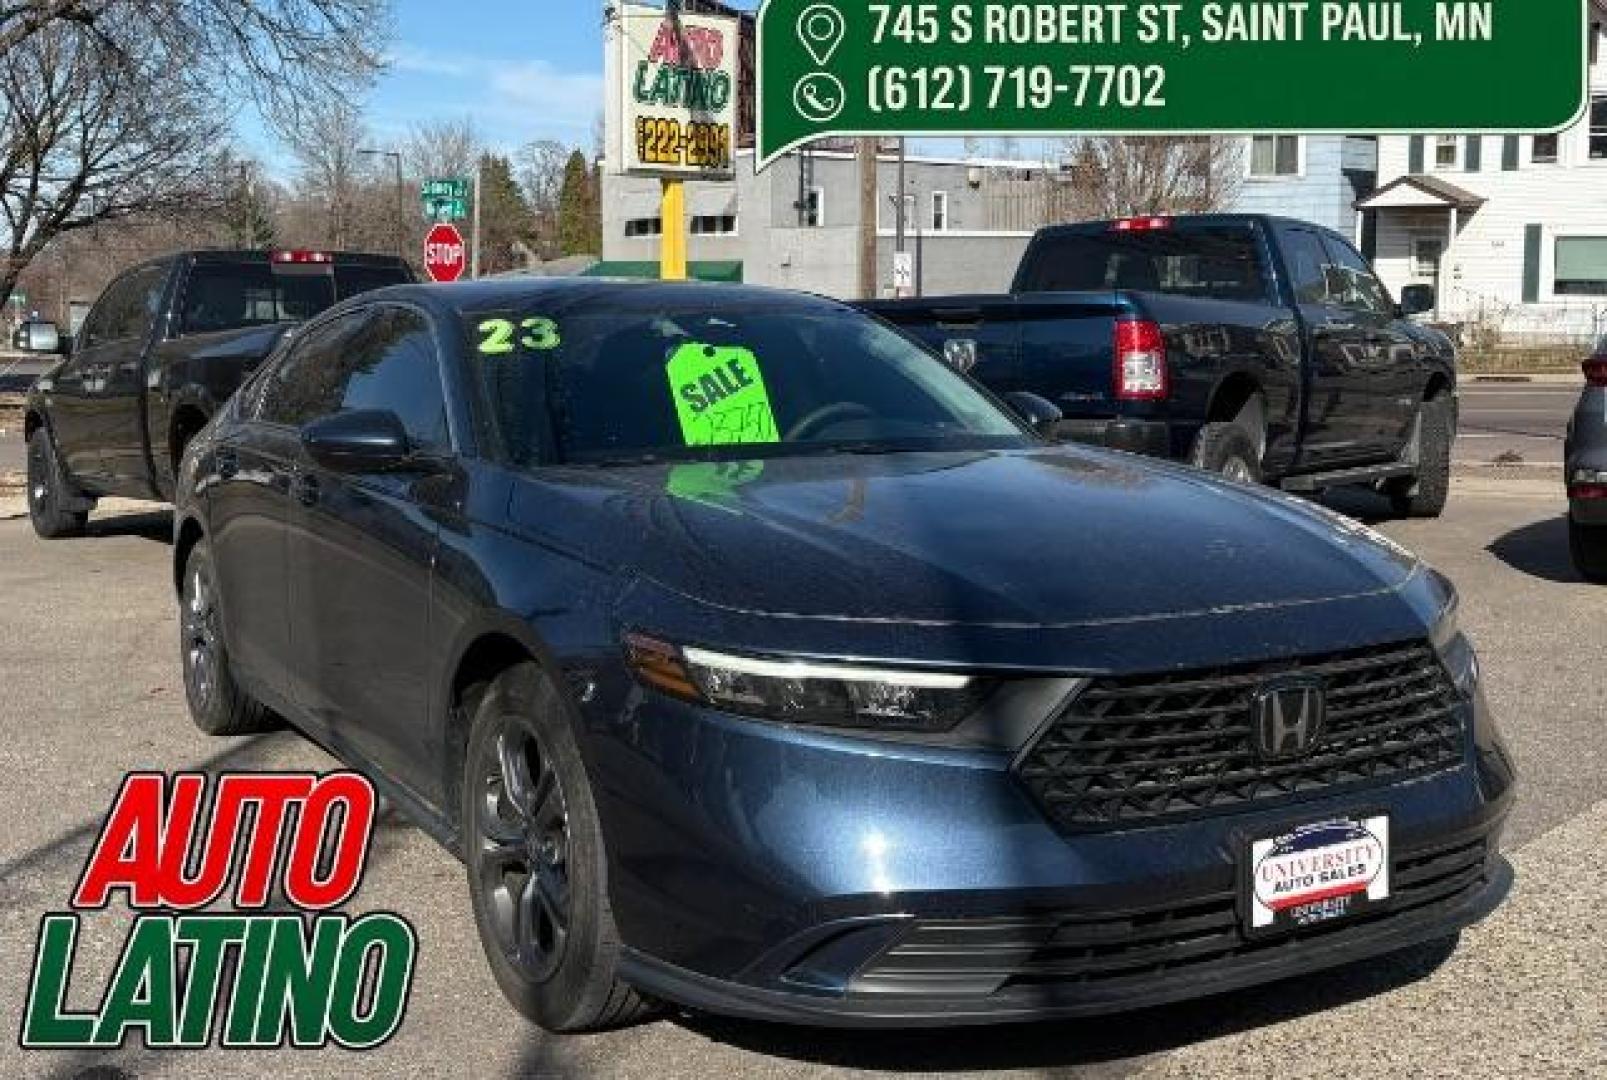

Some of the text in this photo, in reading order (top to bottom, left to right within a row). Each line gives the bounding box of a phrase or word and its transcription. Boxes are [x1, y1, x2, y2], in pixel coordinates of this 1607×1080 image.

[633, 60, 731, 113] LATINO
[427, 243, 462, 266] STOP
[478, 318, 560, 352] 23
[680, 358, 754, 413] SALE
[1262, 843, 1377, 883] UNIVERSITY
[1274, 863, 1367, 893] AUTO SALES
